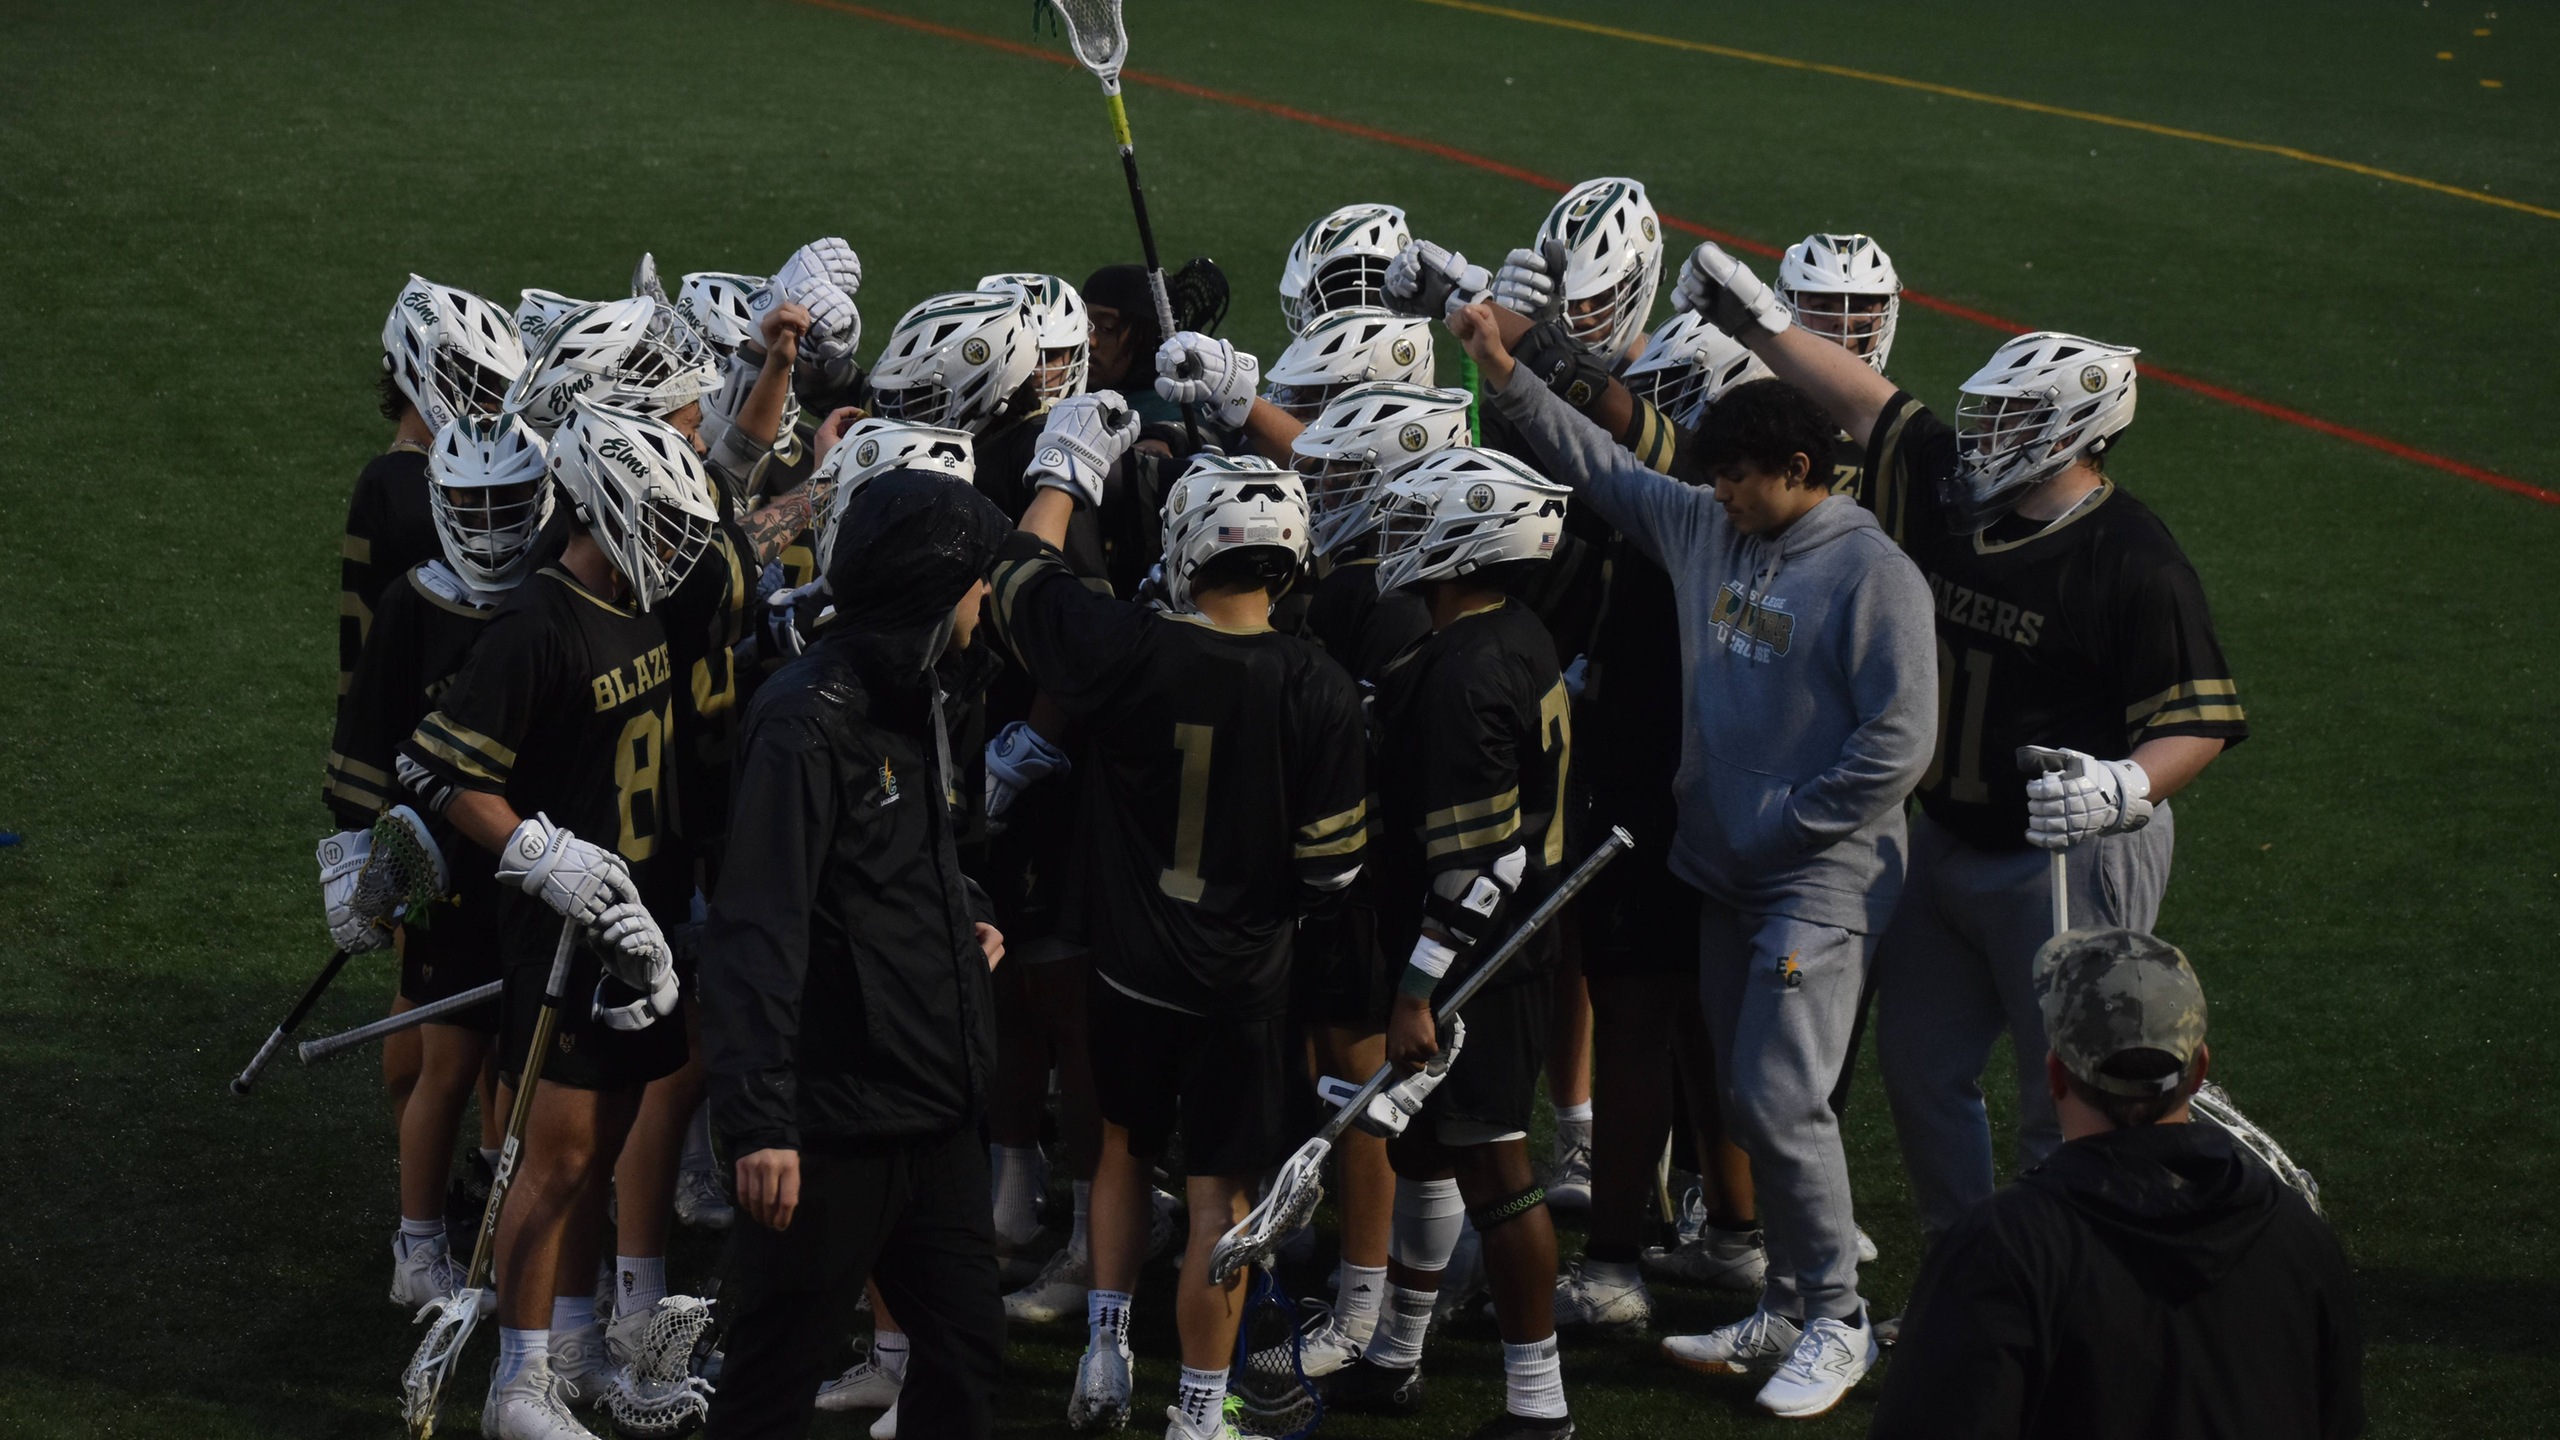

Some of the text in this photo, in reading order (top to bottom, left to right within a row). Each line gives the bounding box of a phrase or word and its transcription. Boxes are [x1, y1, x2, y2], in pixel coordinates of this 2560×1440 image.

[403, 291, 439, 326] Elms
[676, 296, 700, 330] Elms
[548, 373, 594, 415] Elms
[599, 438, 649, 478] Elms
[944, 456, 955, 468] 22
[1058, 436, 1104, 467] WARRIOR
[1260, 501, 1264, 512] 1
[1929, 571, 2045, 647] AZERS
[1158, 722, 1214, 903] 1
[495, 1135, 520, 1190] STX
